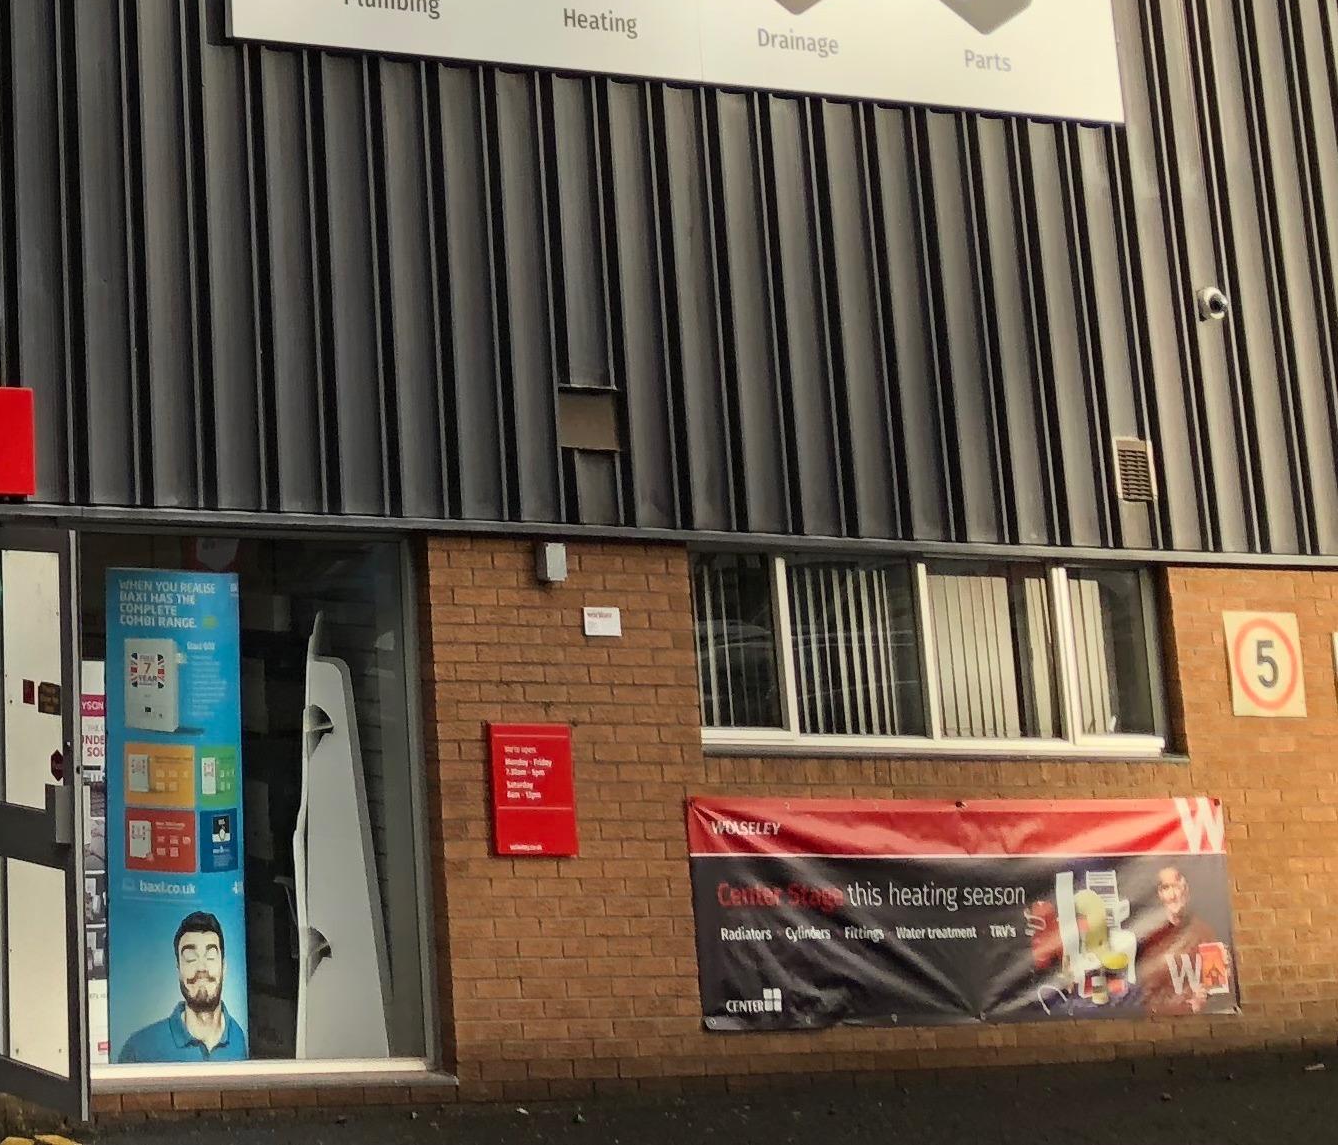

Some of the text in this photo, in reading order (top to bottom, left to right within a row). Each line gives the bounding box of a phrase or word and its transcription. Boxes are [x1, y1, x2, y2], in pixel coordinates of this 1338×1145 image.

[562, 8, 638, 40] Heating
[757, 27, 840, 57] Drainage
[964, 49, 1012, 72] Parts
[119, 580, 152, 591] WHEN
[155, 581, 178, 592] YOU
[180, 583, 216, 594] REALISE
[119, 591, 196, 605] BAXI HAS THE
[119, 603, 177, 616] COMPLETE
[120, 615, 155, 626] COMBI
[143, 663, 151, 674] 7
[1256, 639, 1279, 688] 5
[82, 701, 104, 710] YSON
[710, 820, 781, 836] WOLSELEY
[1174, 797, 1225, 855] W
[140, 880, 196, 894] baxi.co.uk
[717, 881, 1026, 916] Center Stage this heating season
[721, 924, 1017, 943] Radiators Cylinders Fittings Water treatment TRV's
[726, 999, 764, 1013] CENTER
